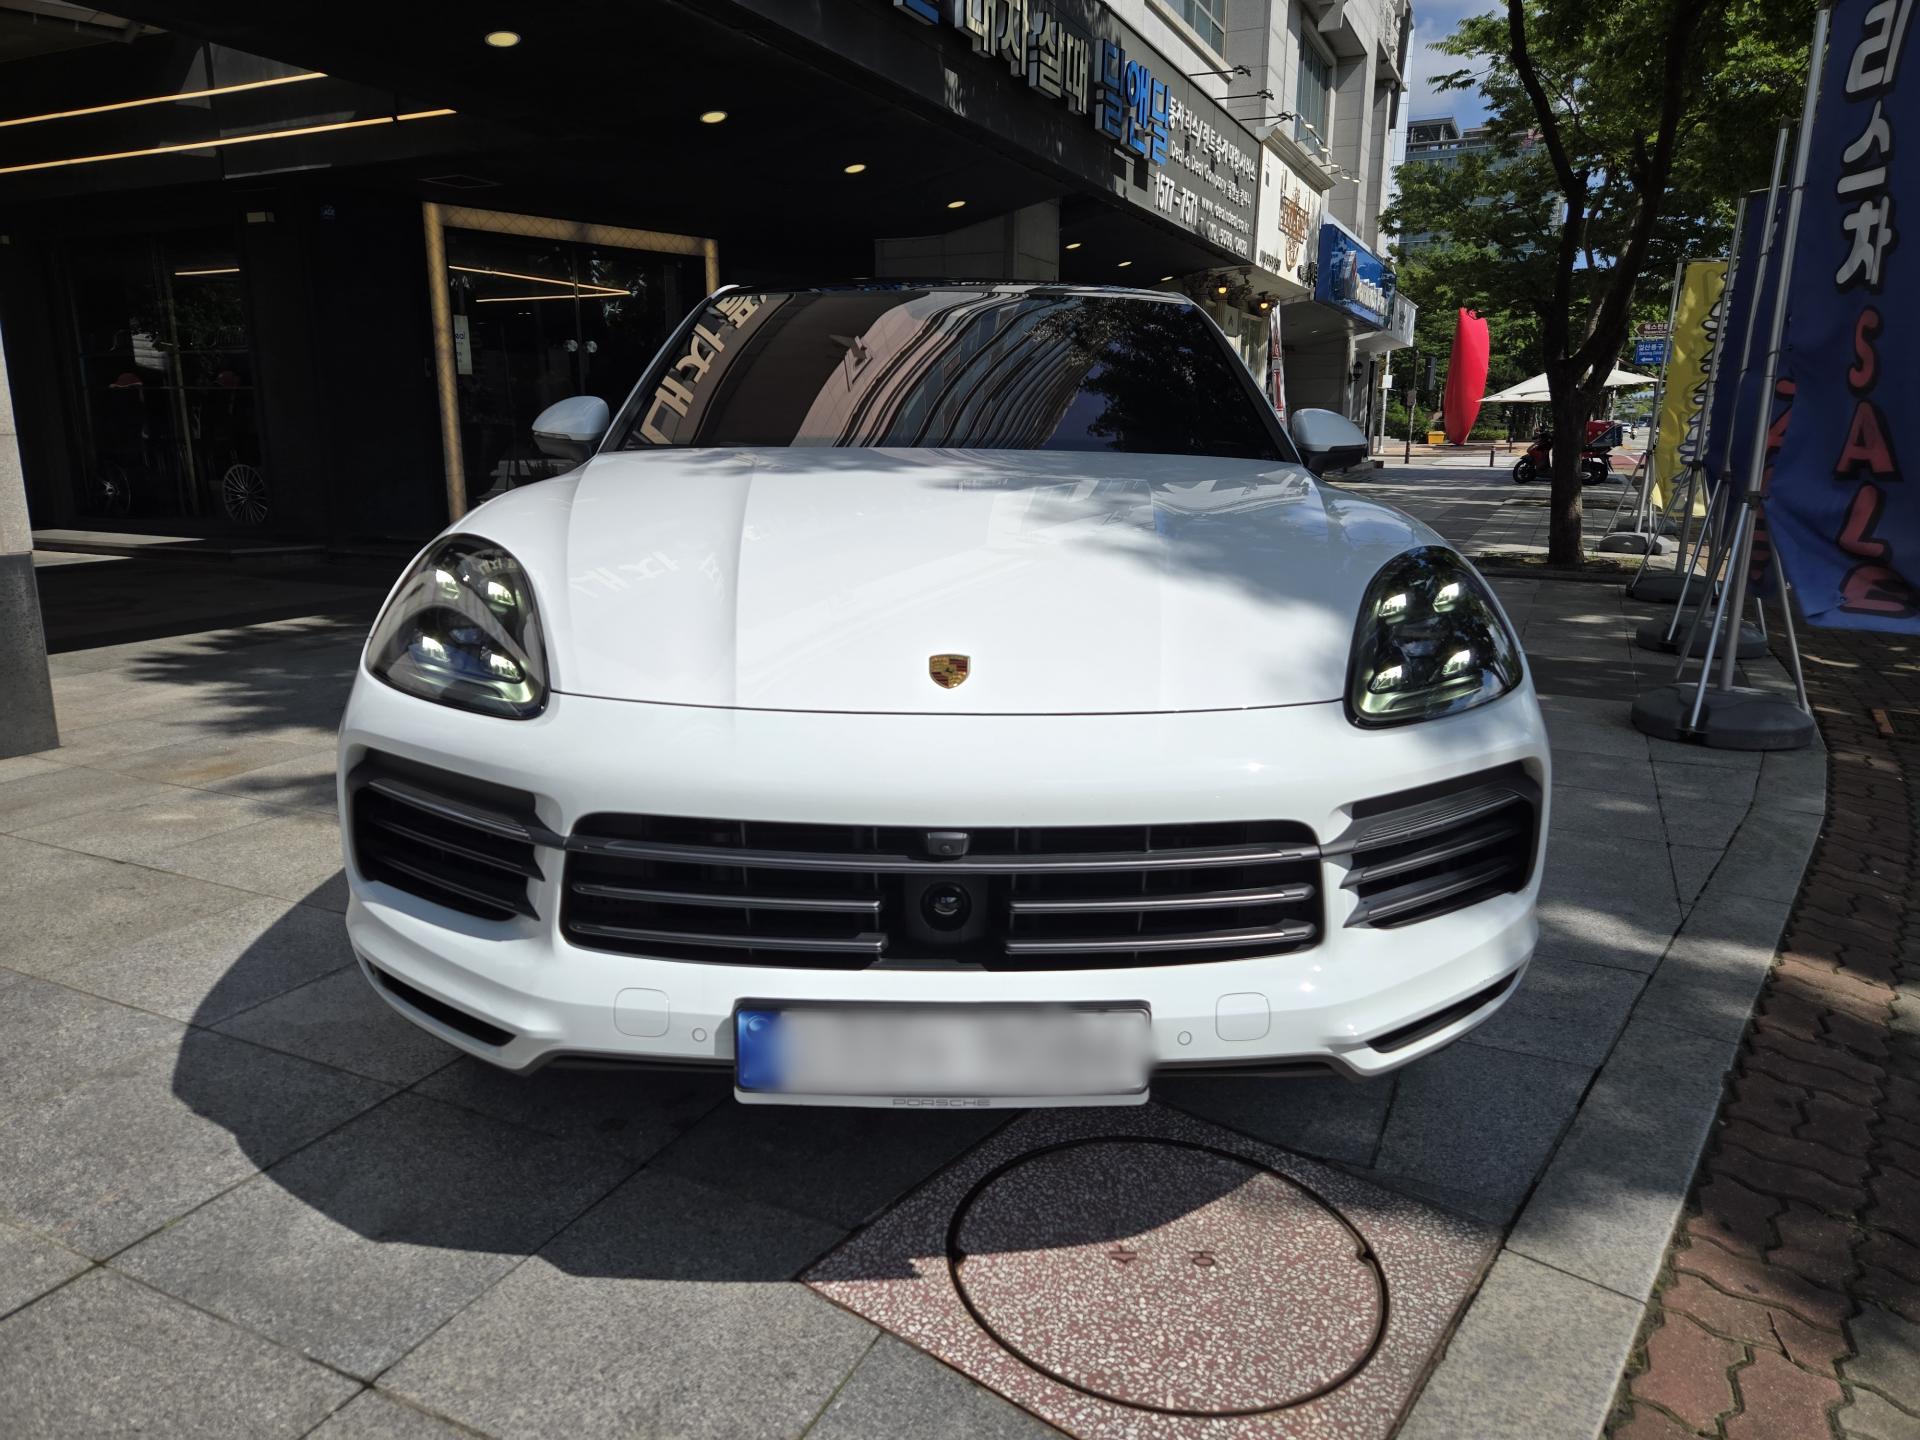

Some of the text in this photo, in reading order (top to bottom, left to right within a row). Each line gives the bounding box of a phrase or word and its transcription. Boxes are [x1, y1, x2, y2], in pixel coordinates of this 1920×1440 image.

[1102, 38, 1171, 166] 딜앤딜
[1836, 0, 1913, 285] 리스차
[1639, 343, 1664, 351] 일산동구
[1835, 308, 1908, 613] SALE
[893, 1098, 991, 1107] PORSCHE
